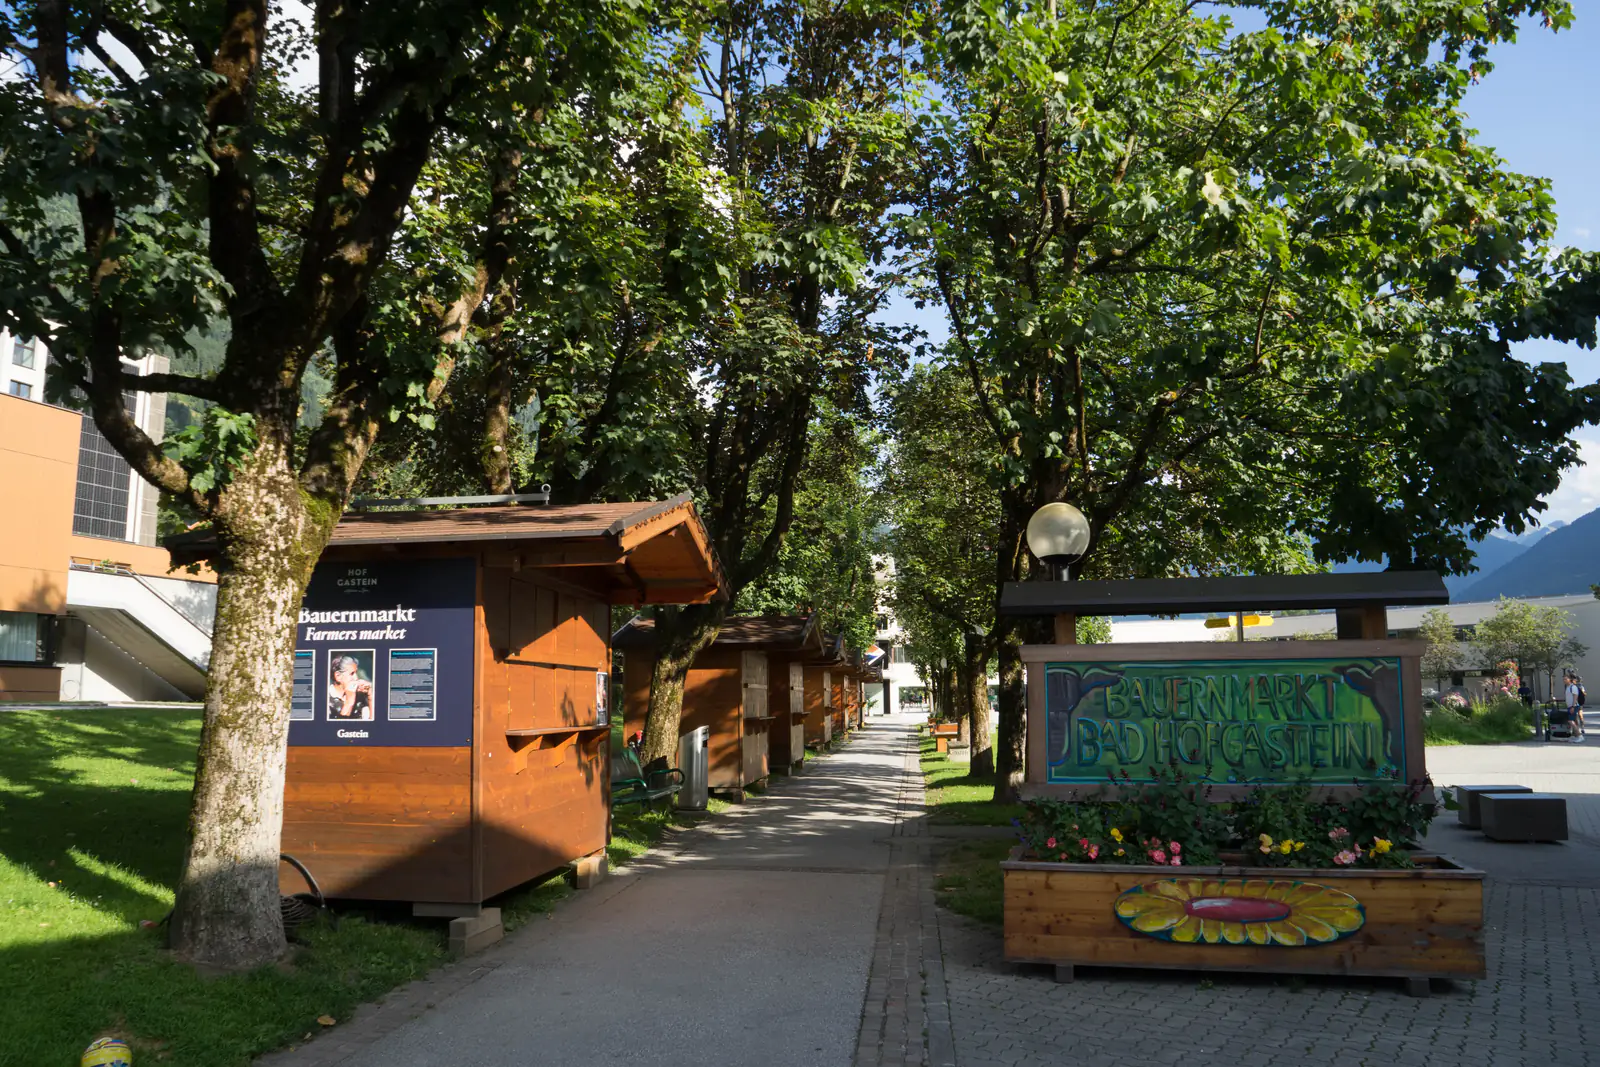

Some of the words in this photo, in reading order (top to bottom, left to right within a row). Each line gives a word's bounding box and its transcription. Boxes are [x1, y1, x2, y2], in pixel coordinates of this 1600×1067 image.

[348, 568, 368, 577] HOF
[337, 578, 378, 586] GASTEIN
[297, 604, 416, 624] Bauernmarkt
[305, 627, 358, 641] Farmers
[359, 625, 407, 640] market
[1104, 672, 1344, 721] BAUERNMARKT
[337, 729, 369, 738] Gastein
[1077, 717, 1148, 766] BAD
